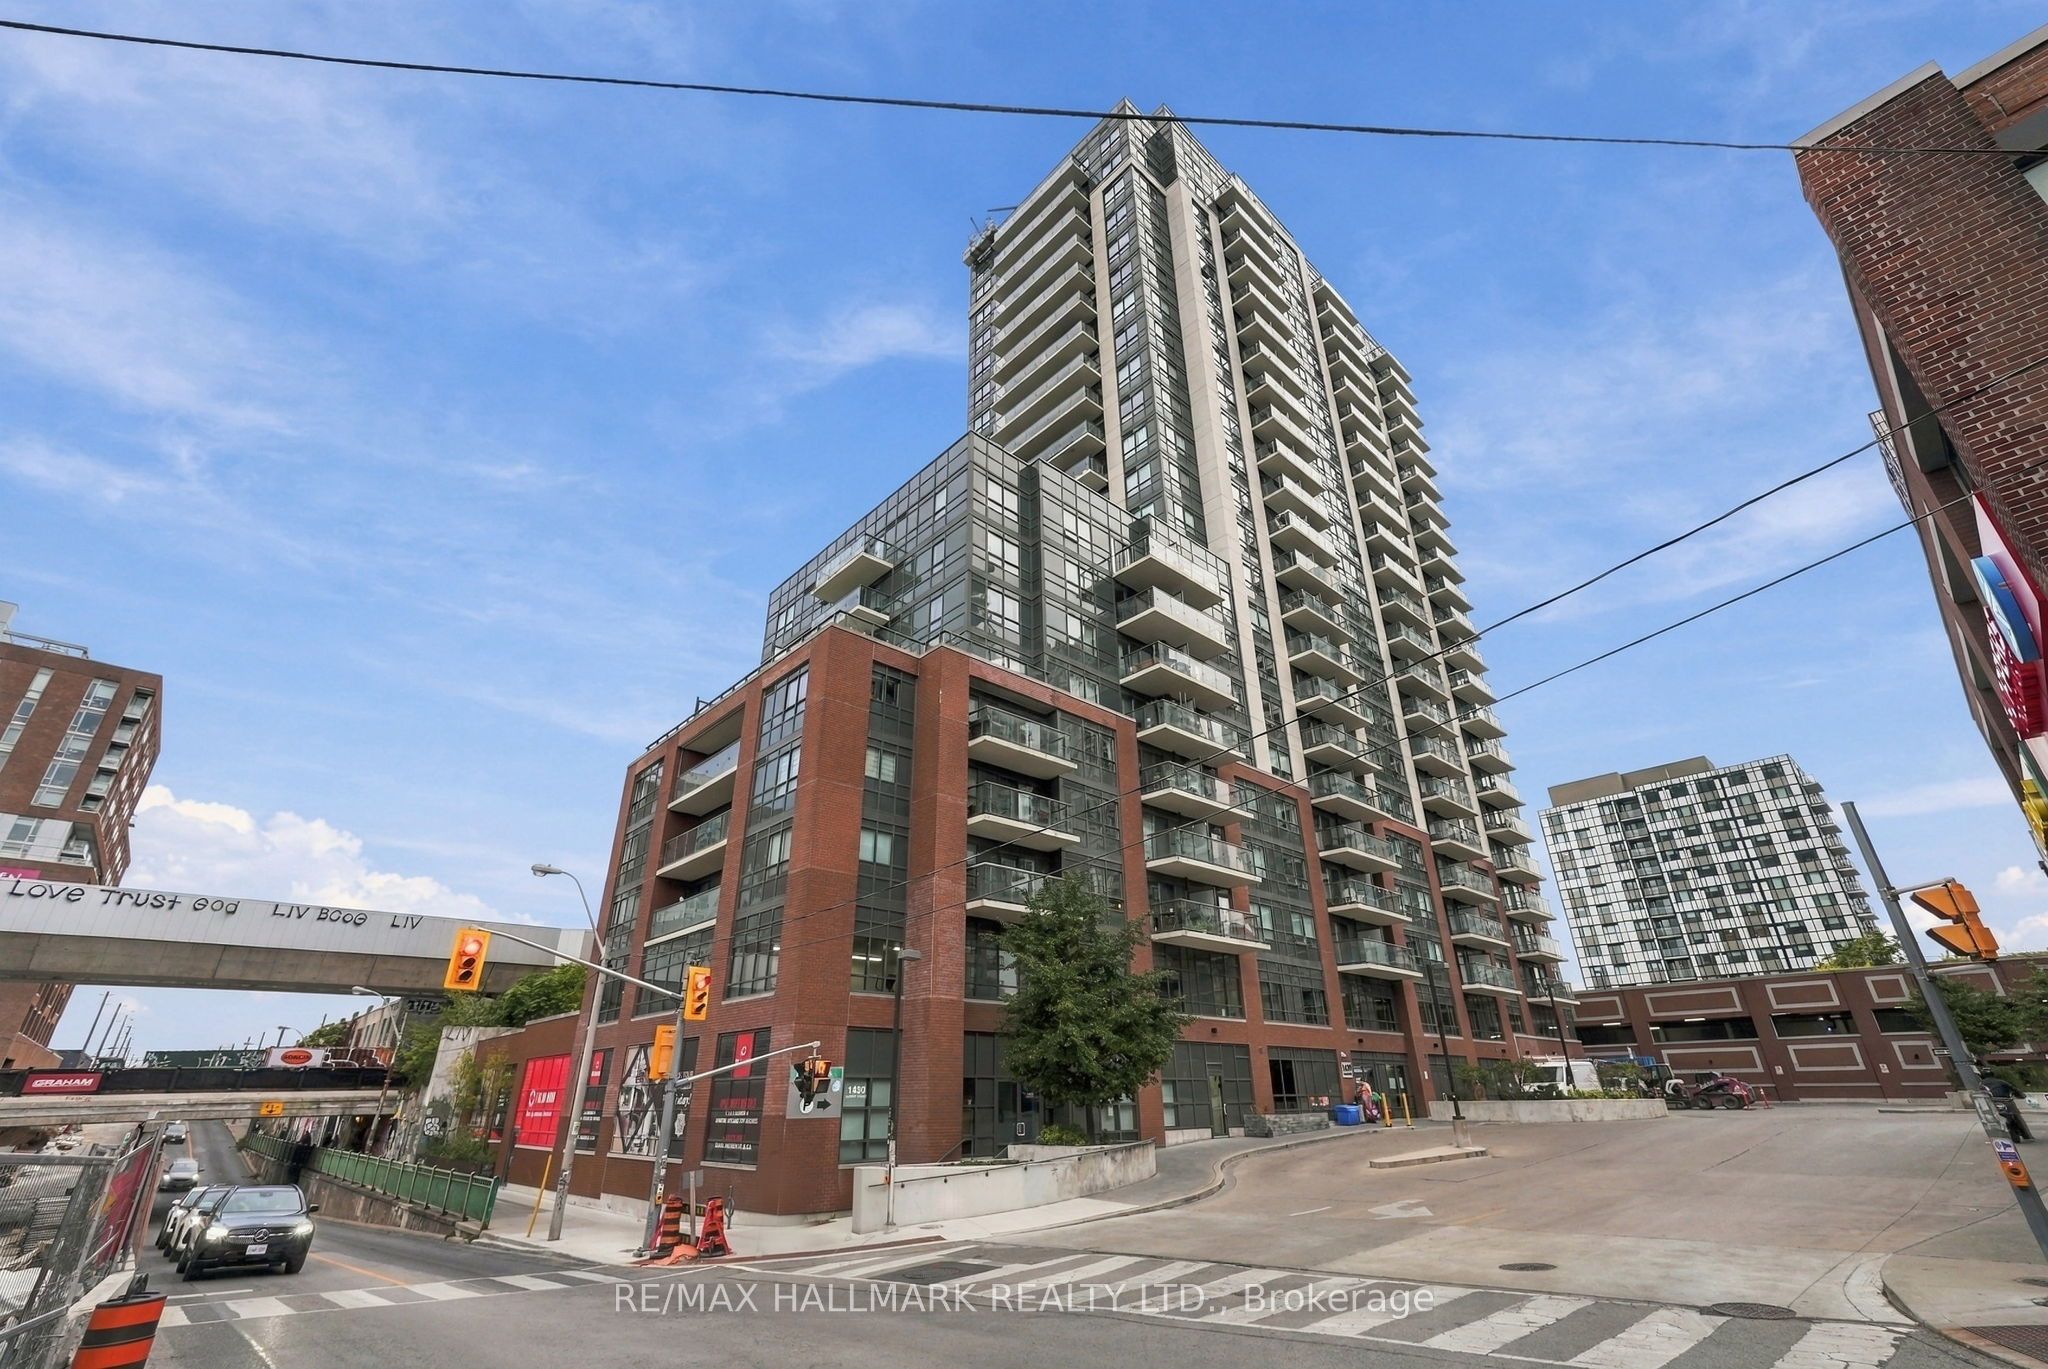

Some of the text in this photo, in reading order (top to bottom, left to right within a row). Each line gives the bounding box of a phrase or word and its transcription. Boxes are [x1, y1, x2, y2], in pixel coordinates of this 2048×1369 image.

[272, 903, 310, 919] LIV
[391, 915, 424, 929] LIV
[32, 1078, 94, 1088] GRAHAM
